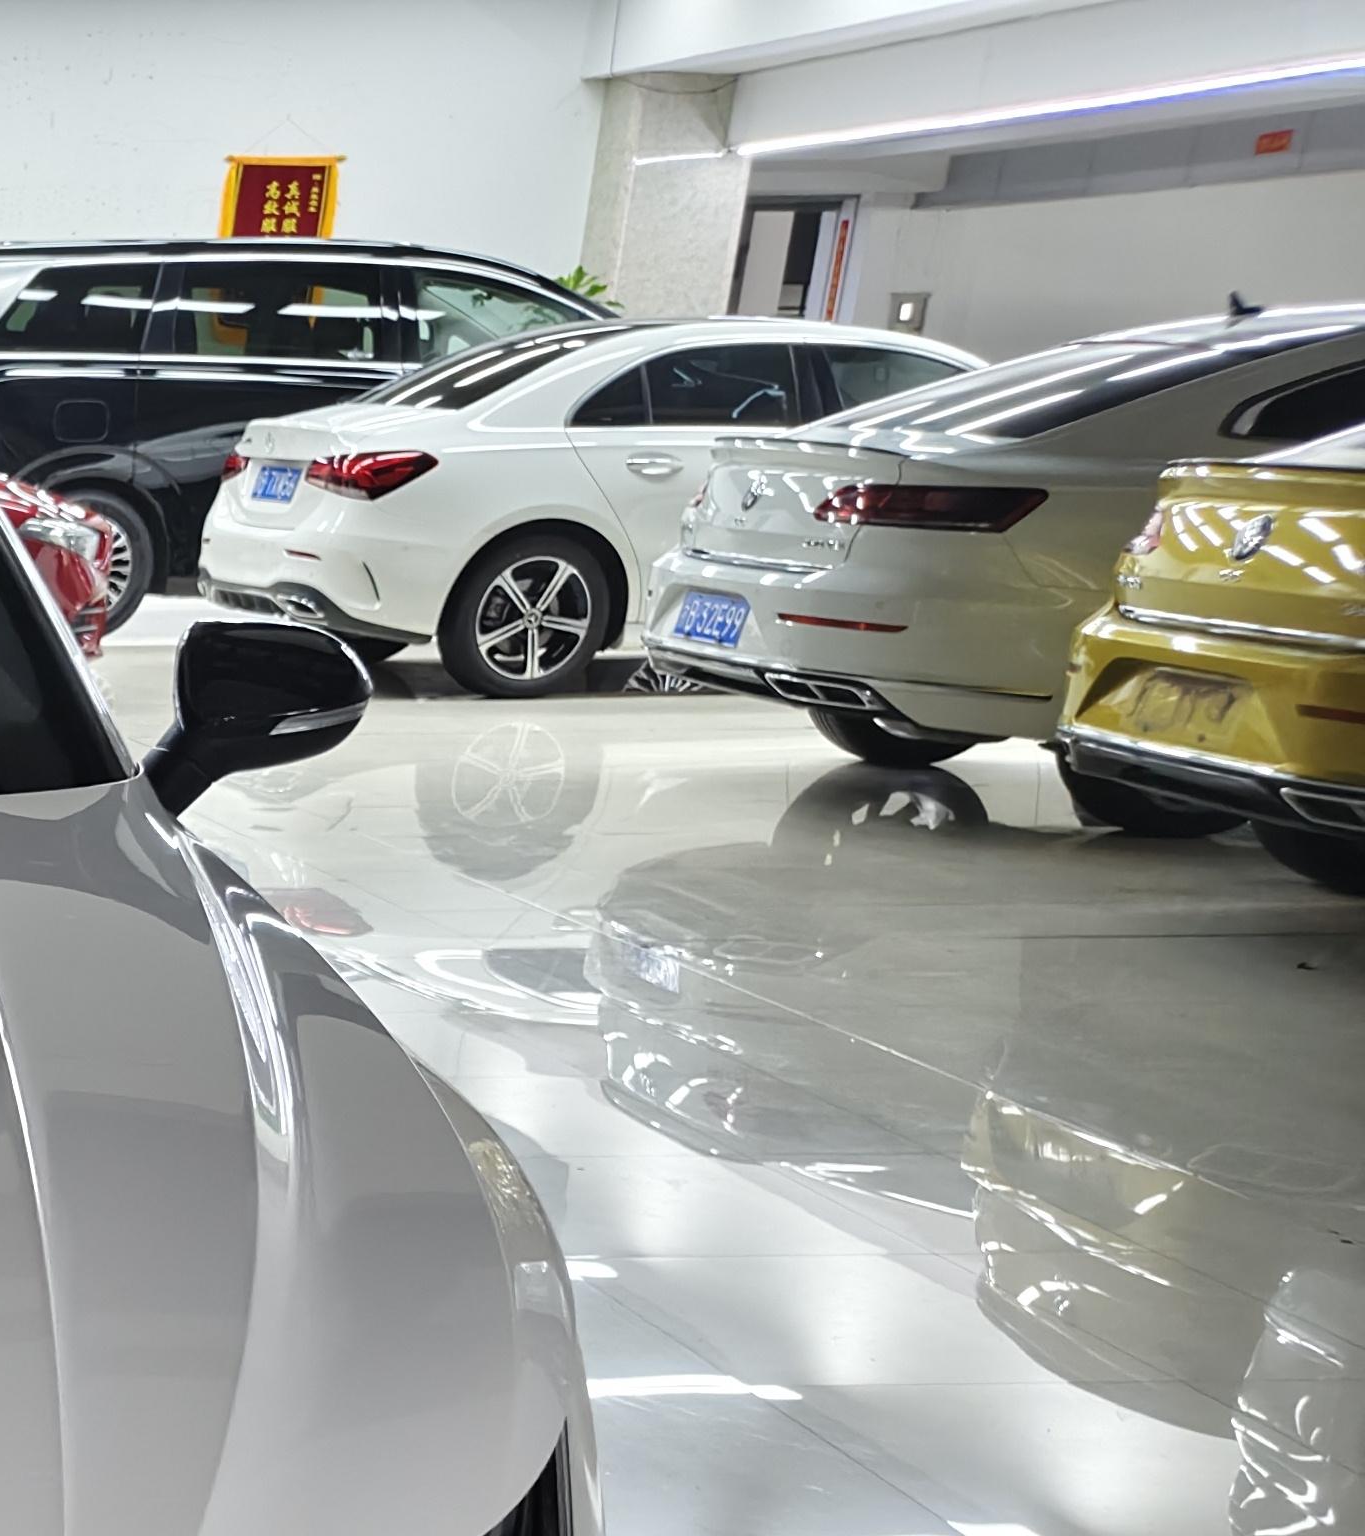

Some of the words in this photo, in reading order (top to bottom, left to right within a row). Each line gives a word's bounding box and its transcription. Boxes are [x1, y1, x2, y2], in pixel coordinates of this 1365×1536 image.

[260, 180, 281, 237] 高效服
[281, 180, 301, 237] 真诚服
